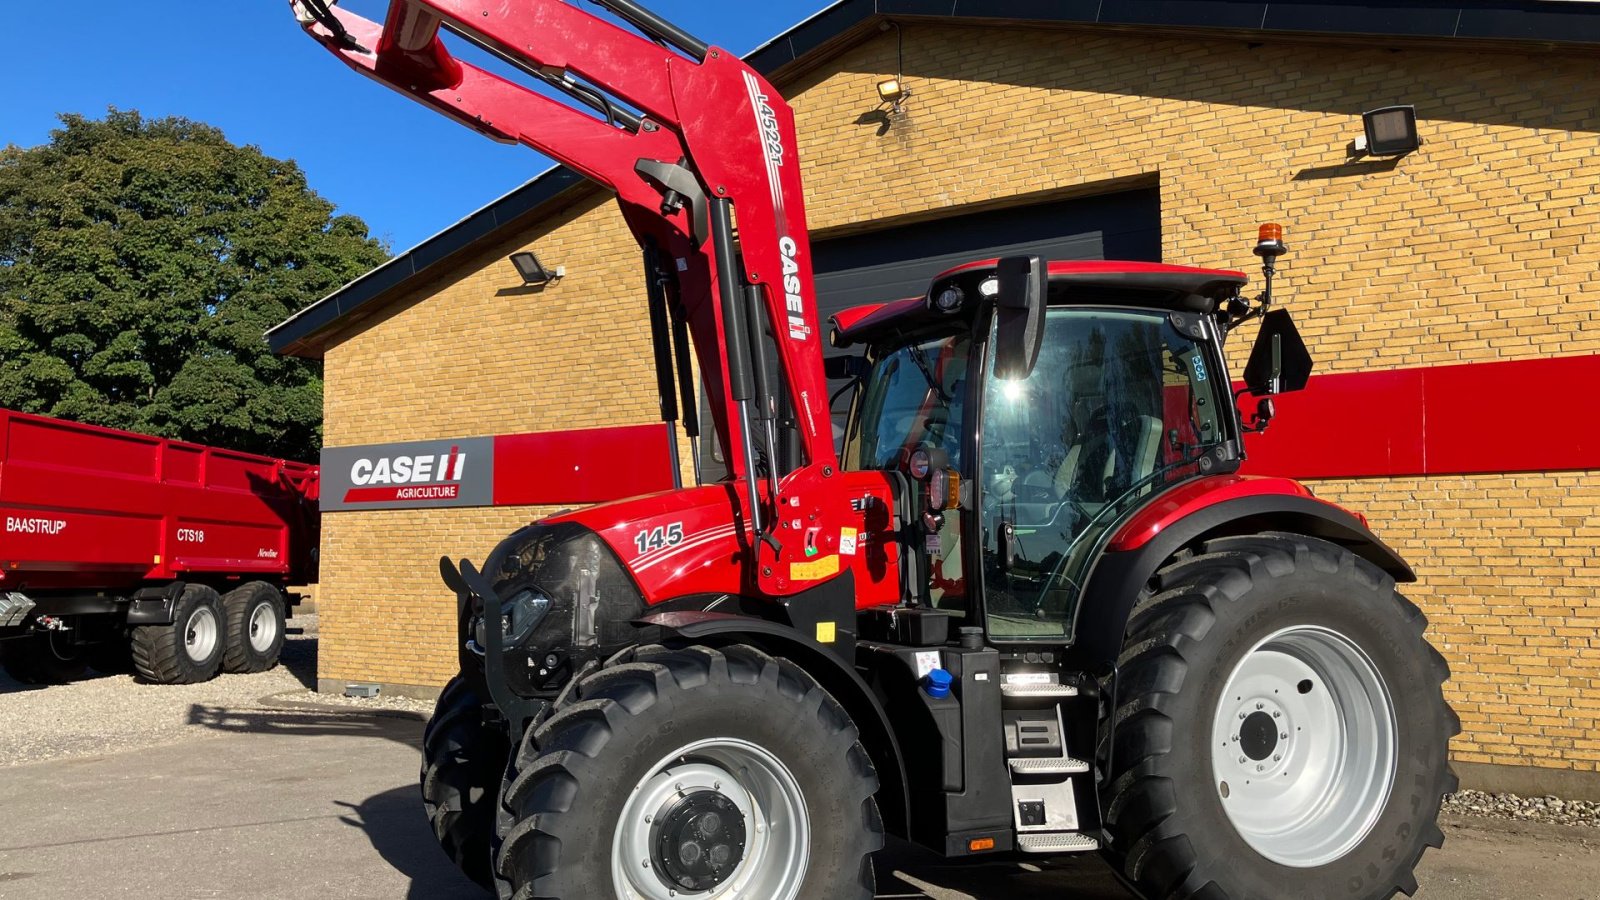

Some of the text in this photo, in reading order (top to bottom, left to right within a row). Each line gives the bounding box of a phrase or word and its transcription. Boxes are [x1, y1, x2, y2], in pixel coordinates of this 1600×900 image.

[779, 236, 804, 313] CASE
[351, 454, 434, 485] CASE
[396, 486, 455, 498] AGRICULTURE
[177, 528, 204, 542] CTS18
[634, 521, 683, 554] 145
